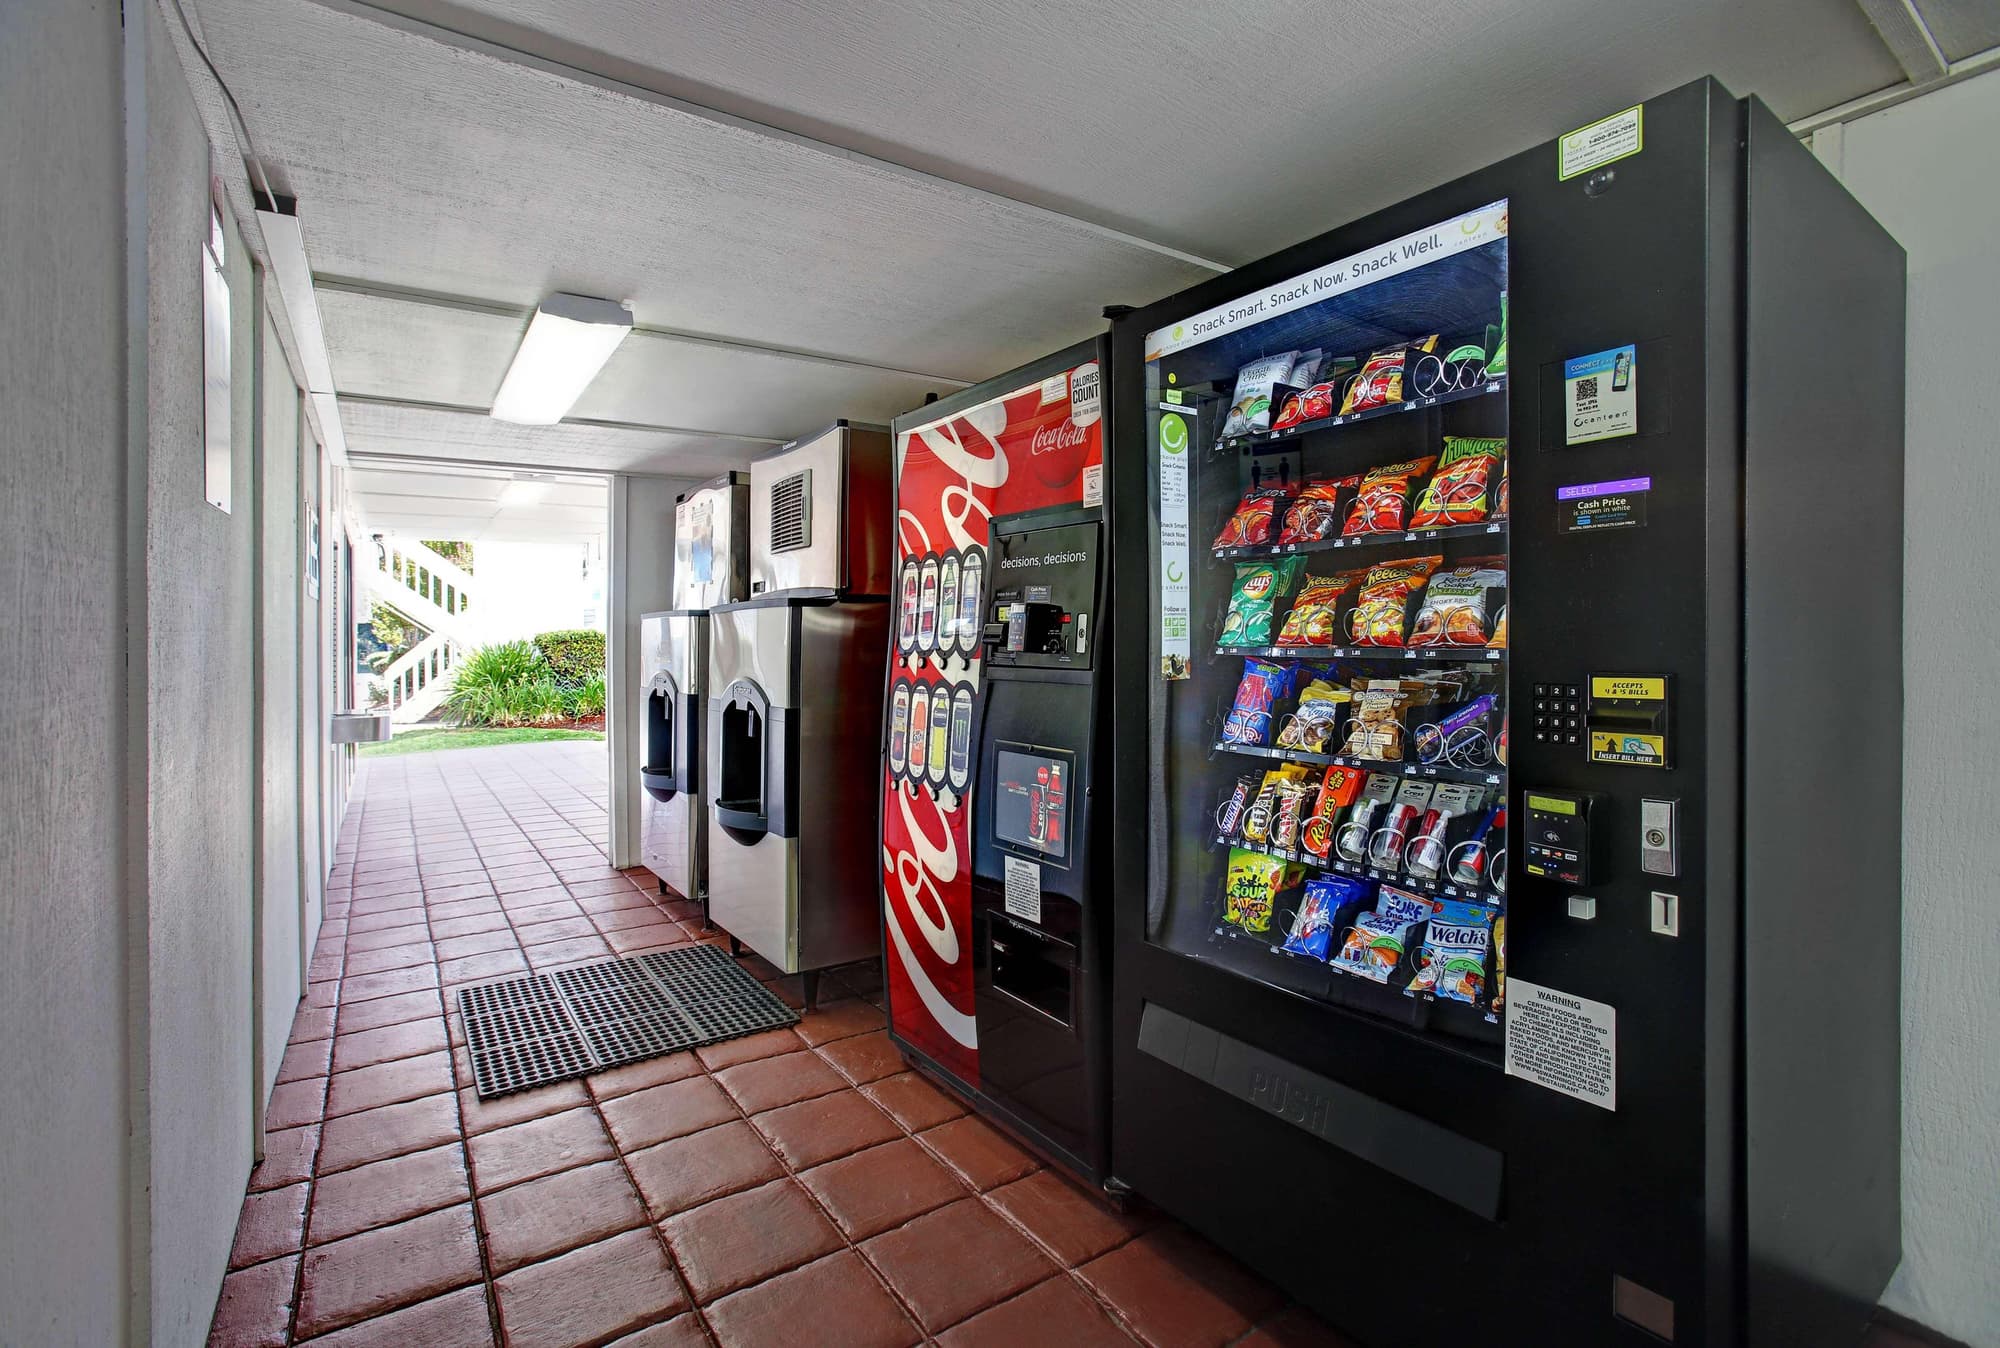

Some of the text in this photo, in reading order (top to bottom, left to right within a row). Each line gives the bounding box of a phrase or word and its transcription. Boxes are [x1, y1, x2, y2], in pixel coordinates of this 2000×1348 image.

[1192, 233, 1443, 336] Snack Smart. Snack Now. Snack Well.
[1072, 371, 1099, 390] CALORIES
[1072, 382, 1099, 405] COUNT
[1584, 410, 1629, 424] canteen
[1032, 416, 1087, 456] Coca-Cola
[1565, 485, 1598, 497] SELECT
[1577, 497, 1627, 510] Cash Price
[1001, 550, 1087, 569] decisions, decisions
[1554, 687, 1560, 695] 2
[1570, 688, 1576, 696] 3
[1598, 752, 1620, 760] INSERT
[1370, 782, 1390, 790] Crest
[1403, 789, 1425, 798] Crest
[1439, 793, 1462, 802] Crest
[1221, 790, 1244, 835] SNICKERS
[1232, 883, 1268, 897] SOUR
[1432, 925, 1487, 946] Welch's
[1527, 1000, 1591, 1024] CERTAIN FOODS AND
[1537, 991, 1582, 1010] WARNING
[1513, 1001, 1607, 1035] BEVERAGES SOLD OR SERVED
[1523, 1010, 1595, 1037] HERE CAN EXPOSE YOU
[1510, 1024, 1530, 1035] BAKED
[1556, 1038, 1569, 1047] AND
[1570, 1043, 1602, 1058] MERCURY
[1511, 1018, 1550, 1036] ACRYLAMIDE
[1559, 1033, 1576, 1044] MANY
[1578, 1040, 1597, 1051] FRIED
[1599, 1046, 1609, 1054] OR
[1528, 1018, 1563, 1034] CHEMICALS
[1565, 1029, 1600, 1045] INCLUDING
[1509, 1036, 1611, 1074] STATE OF CALIFORNIA TO CAUSE
[1509, 1041, 1611, 1080] CANCER AND BIRTH DEFECTS OR
[1525, 1035, 1545, 1046] WHICH
[1547, 1042, 1560, 1051] ARE
[1561, 1046, 1585, 1059] KNOWN
[1587, 1055, 1596, 1063] TO
[1598, 1059, 1611, 1067] THE
[1511, 1054, 1609, 1092] FOR MORE INFORMATION GO TO
[1513, 1049, 1533, 1060] OTHER
[1535, 1056, 1583, 1077] REPRODUCTIVE
[1538, 1075, 1579, 1094] RESTAURANT
